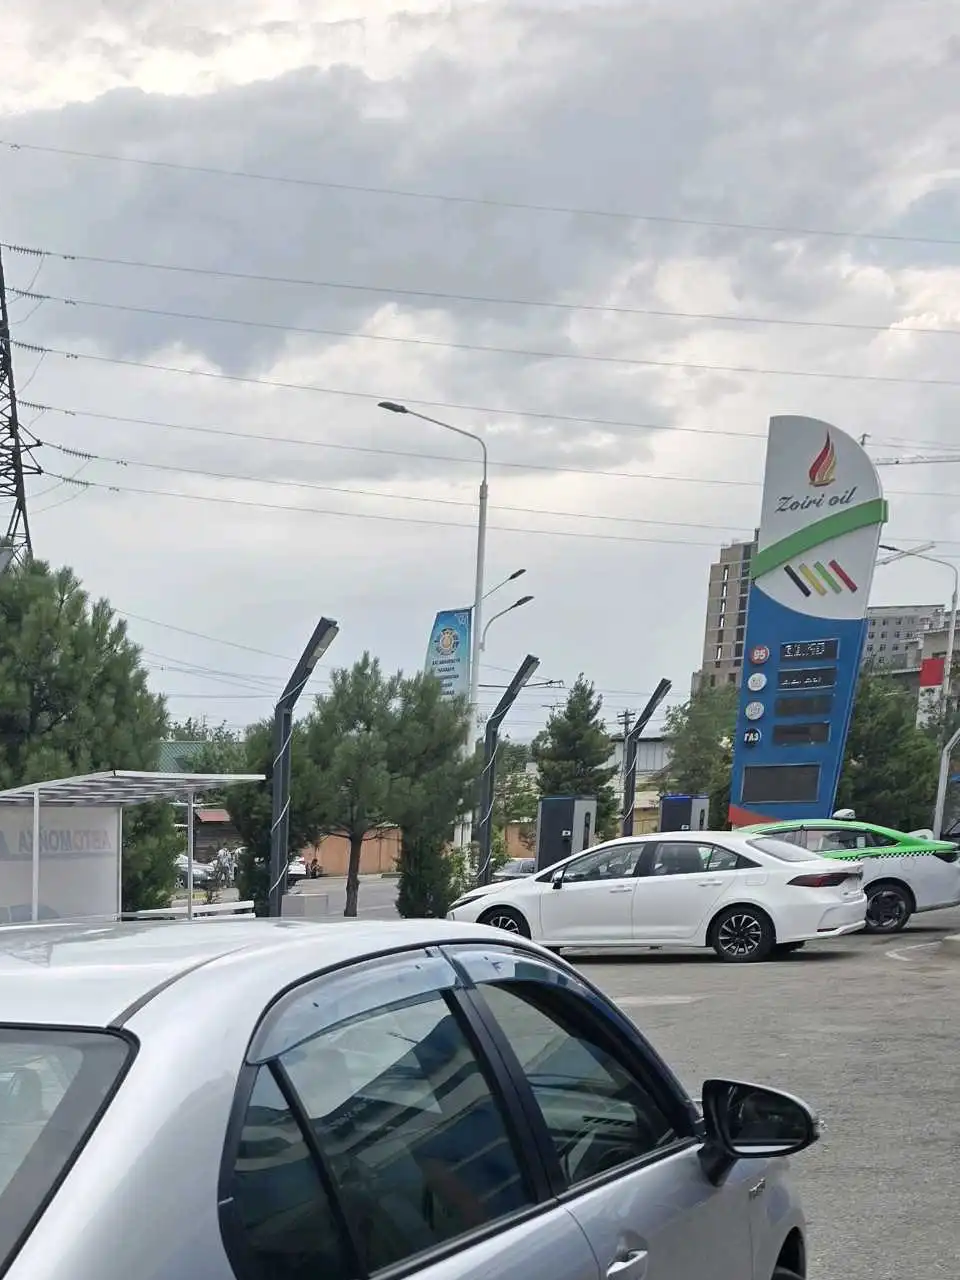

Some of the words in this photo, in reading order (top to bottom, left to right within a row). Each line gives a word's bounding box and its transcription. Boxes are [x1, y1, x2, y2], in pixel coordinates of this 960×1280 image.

[828, 485, 858, 507] oil
[753, 649, 766, 660] 95
[744, 732, 759, 742] ГАЗ
